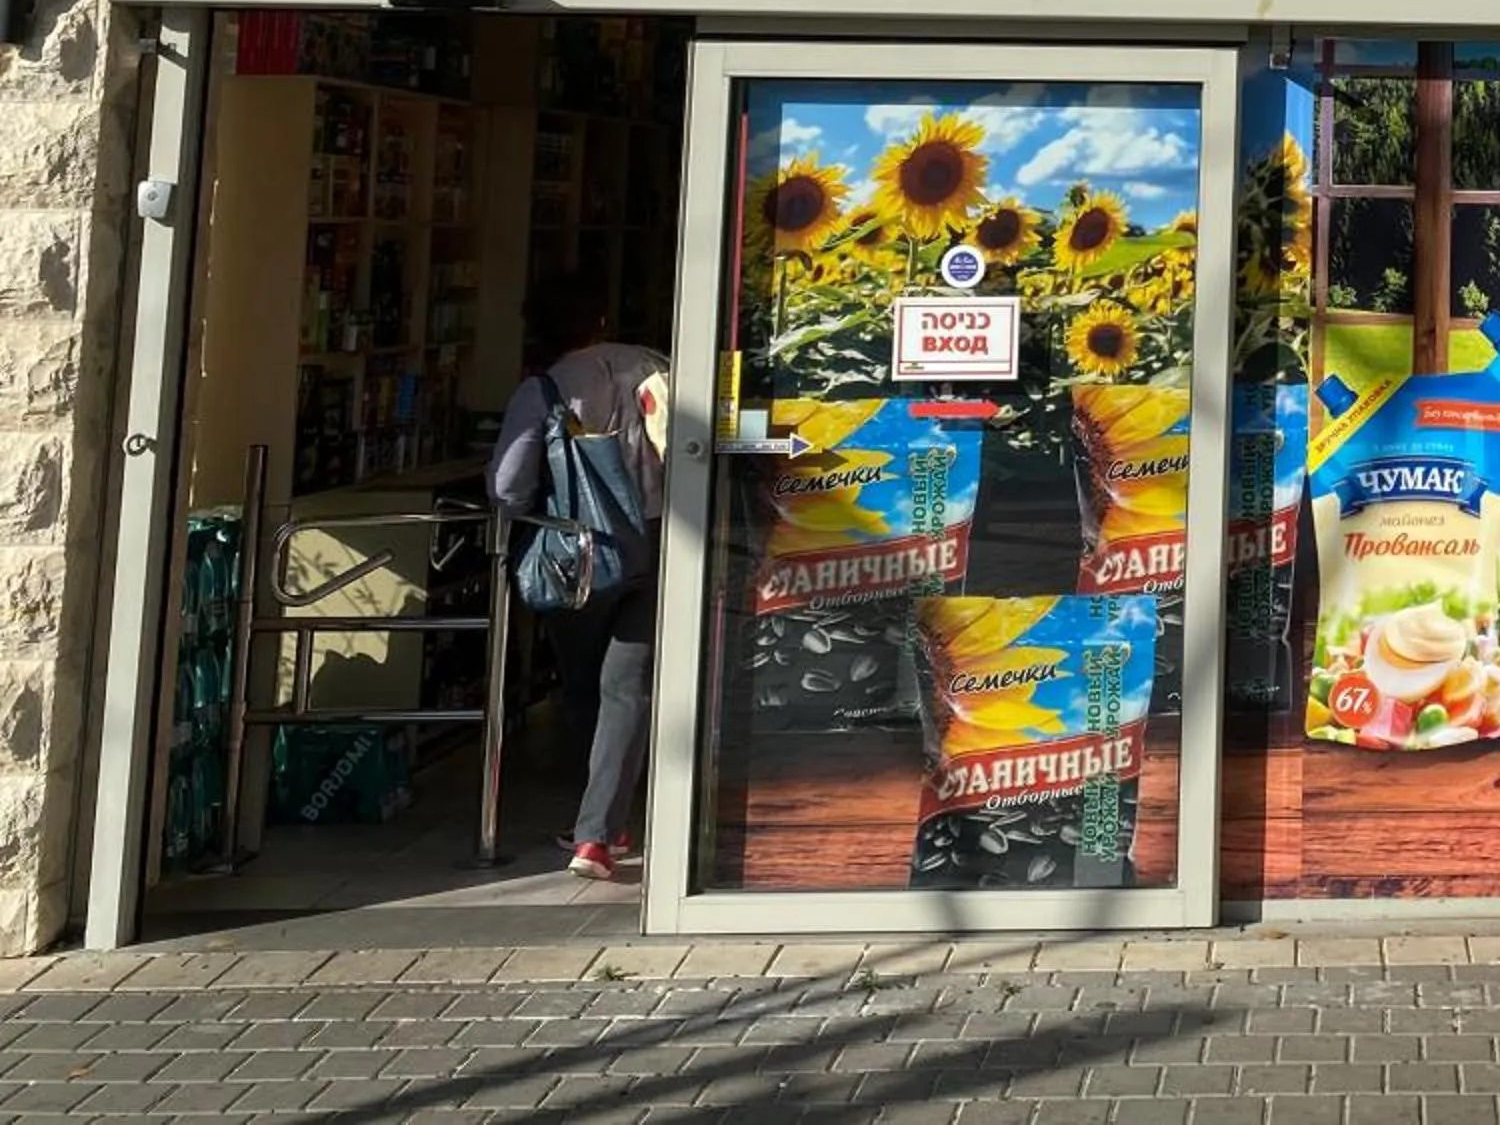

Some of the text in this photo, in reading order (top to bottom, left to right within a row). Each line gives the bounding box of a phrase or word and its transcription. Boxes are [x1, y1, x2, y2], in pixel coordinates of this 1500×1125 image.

[921, 312, 991, 330] כניסה
[922, 335, 988, 355] ВХОД
[774, 466, 882, 496] Семечки
[909, 452, 928, 534] НОВЫЙ
[1358, 466, 1465, 494] ЧУМАК
[1379, 513, 1446, 528] майонез
[760, 537, 957, 602] СТАНИЧНЫЕ
[1342, 531, 1482, 563] Провансаль
[951, 664, 1058, 695] Семечки
[1085, 649, 1102, 732] НОВЫЙ
[1104, 644, 1122, 741] УРОЖАЙ
[301, 735, 372, 821] BORJOMI
[938, 737, 1134, 801] СТАНИЧНЫЕ
[986, 784, 1085, 811] Отборные
[1082, 778, 1100, 855] НОВЫЙ
[1101, 773, 1121, 863] УРОЖАЙ
